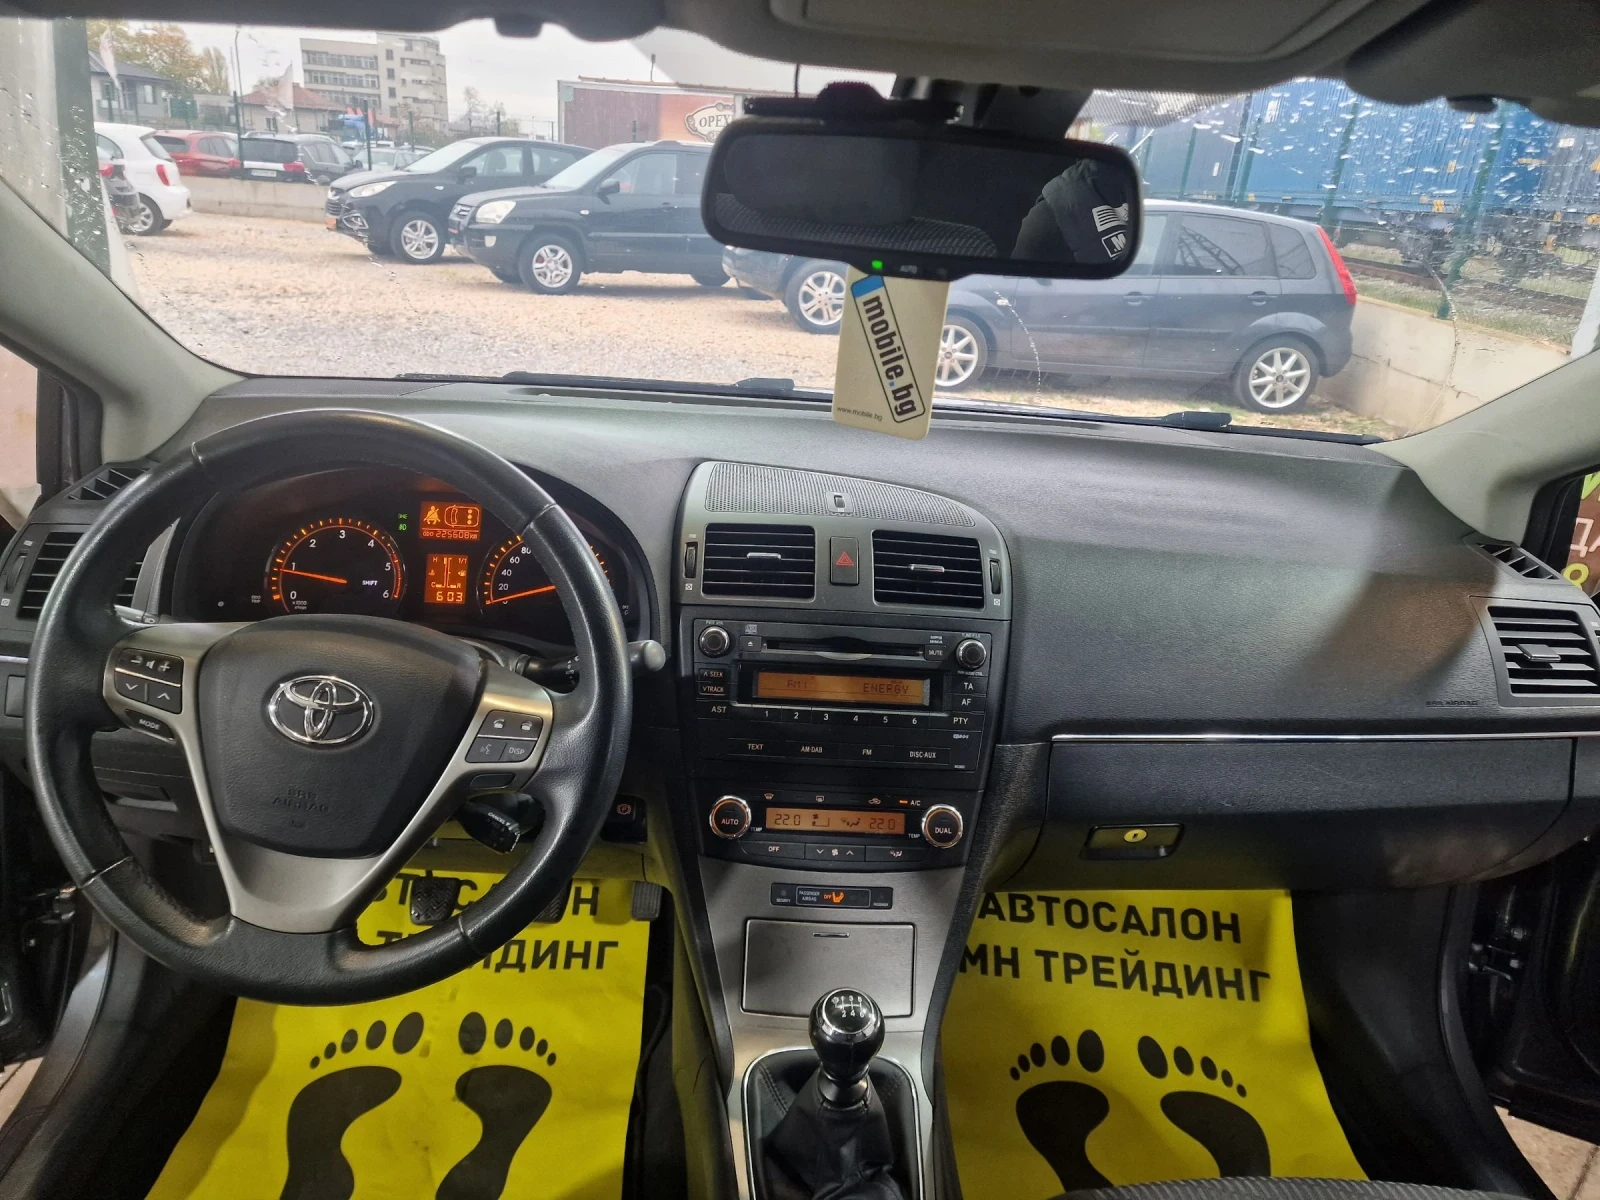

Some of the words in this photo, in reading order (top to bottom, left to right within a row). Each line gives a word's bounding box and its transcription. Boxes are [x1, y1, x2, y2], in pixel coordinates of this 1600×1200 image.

[862, 295, 917, 416] mobile.bg
[837, 406, 883, 422] www.mobile.bg
[339, 530, 346, 539] 3
[435, 531, 470, 539] 225608
[309, 539, 317, 548] 2
[367, 539, 375, 548] 4
[509, 556, 520, 564] 60
[384, 562, 392, 571] 5
[501, 569, 512, 577] 40
[362, 579, 378, 587] SHIFT
[498, 583, 509, 591] 20
[290, 591, 297, 600] 0
[382, 590, 390, 599] 6
[863, 683, 909, 694] ENERGY
[963, 682, 974, 690] TA
[961, 698, 972, 706] AF
[764, 710, 769, 718] 1
[823, 713, 829, 721] 3
[912, 717, 918, 725] 6
[953, 717, 969, 725] PTY
[139, 718, 160, 730] MODE
[508, 746, 525, 755] DISP
[721, 818, 739, 826] AUTO
[774, 813, 801, 826] 22.0
[934, 827, 952, 835] DUAL
[978, 891, 1242, 944] АВТОСАЛОН
[959, 943, 1021, 979] МН
[1034, 948, 1271, 1003] ТРЕЙДИНГ
